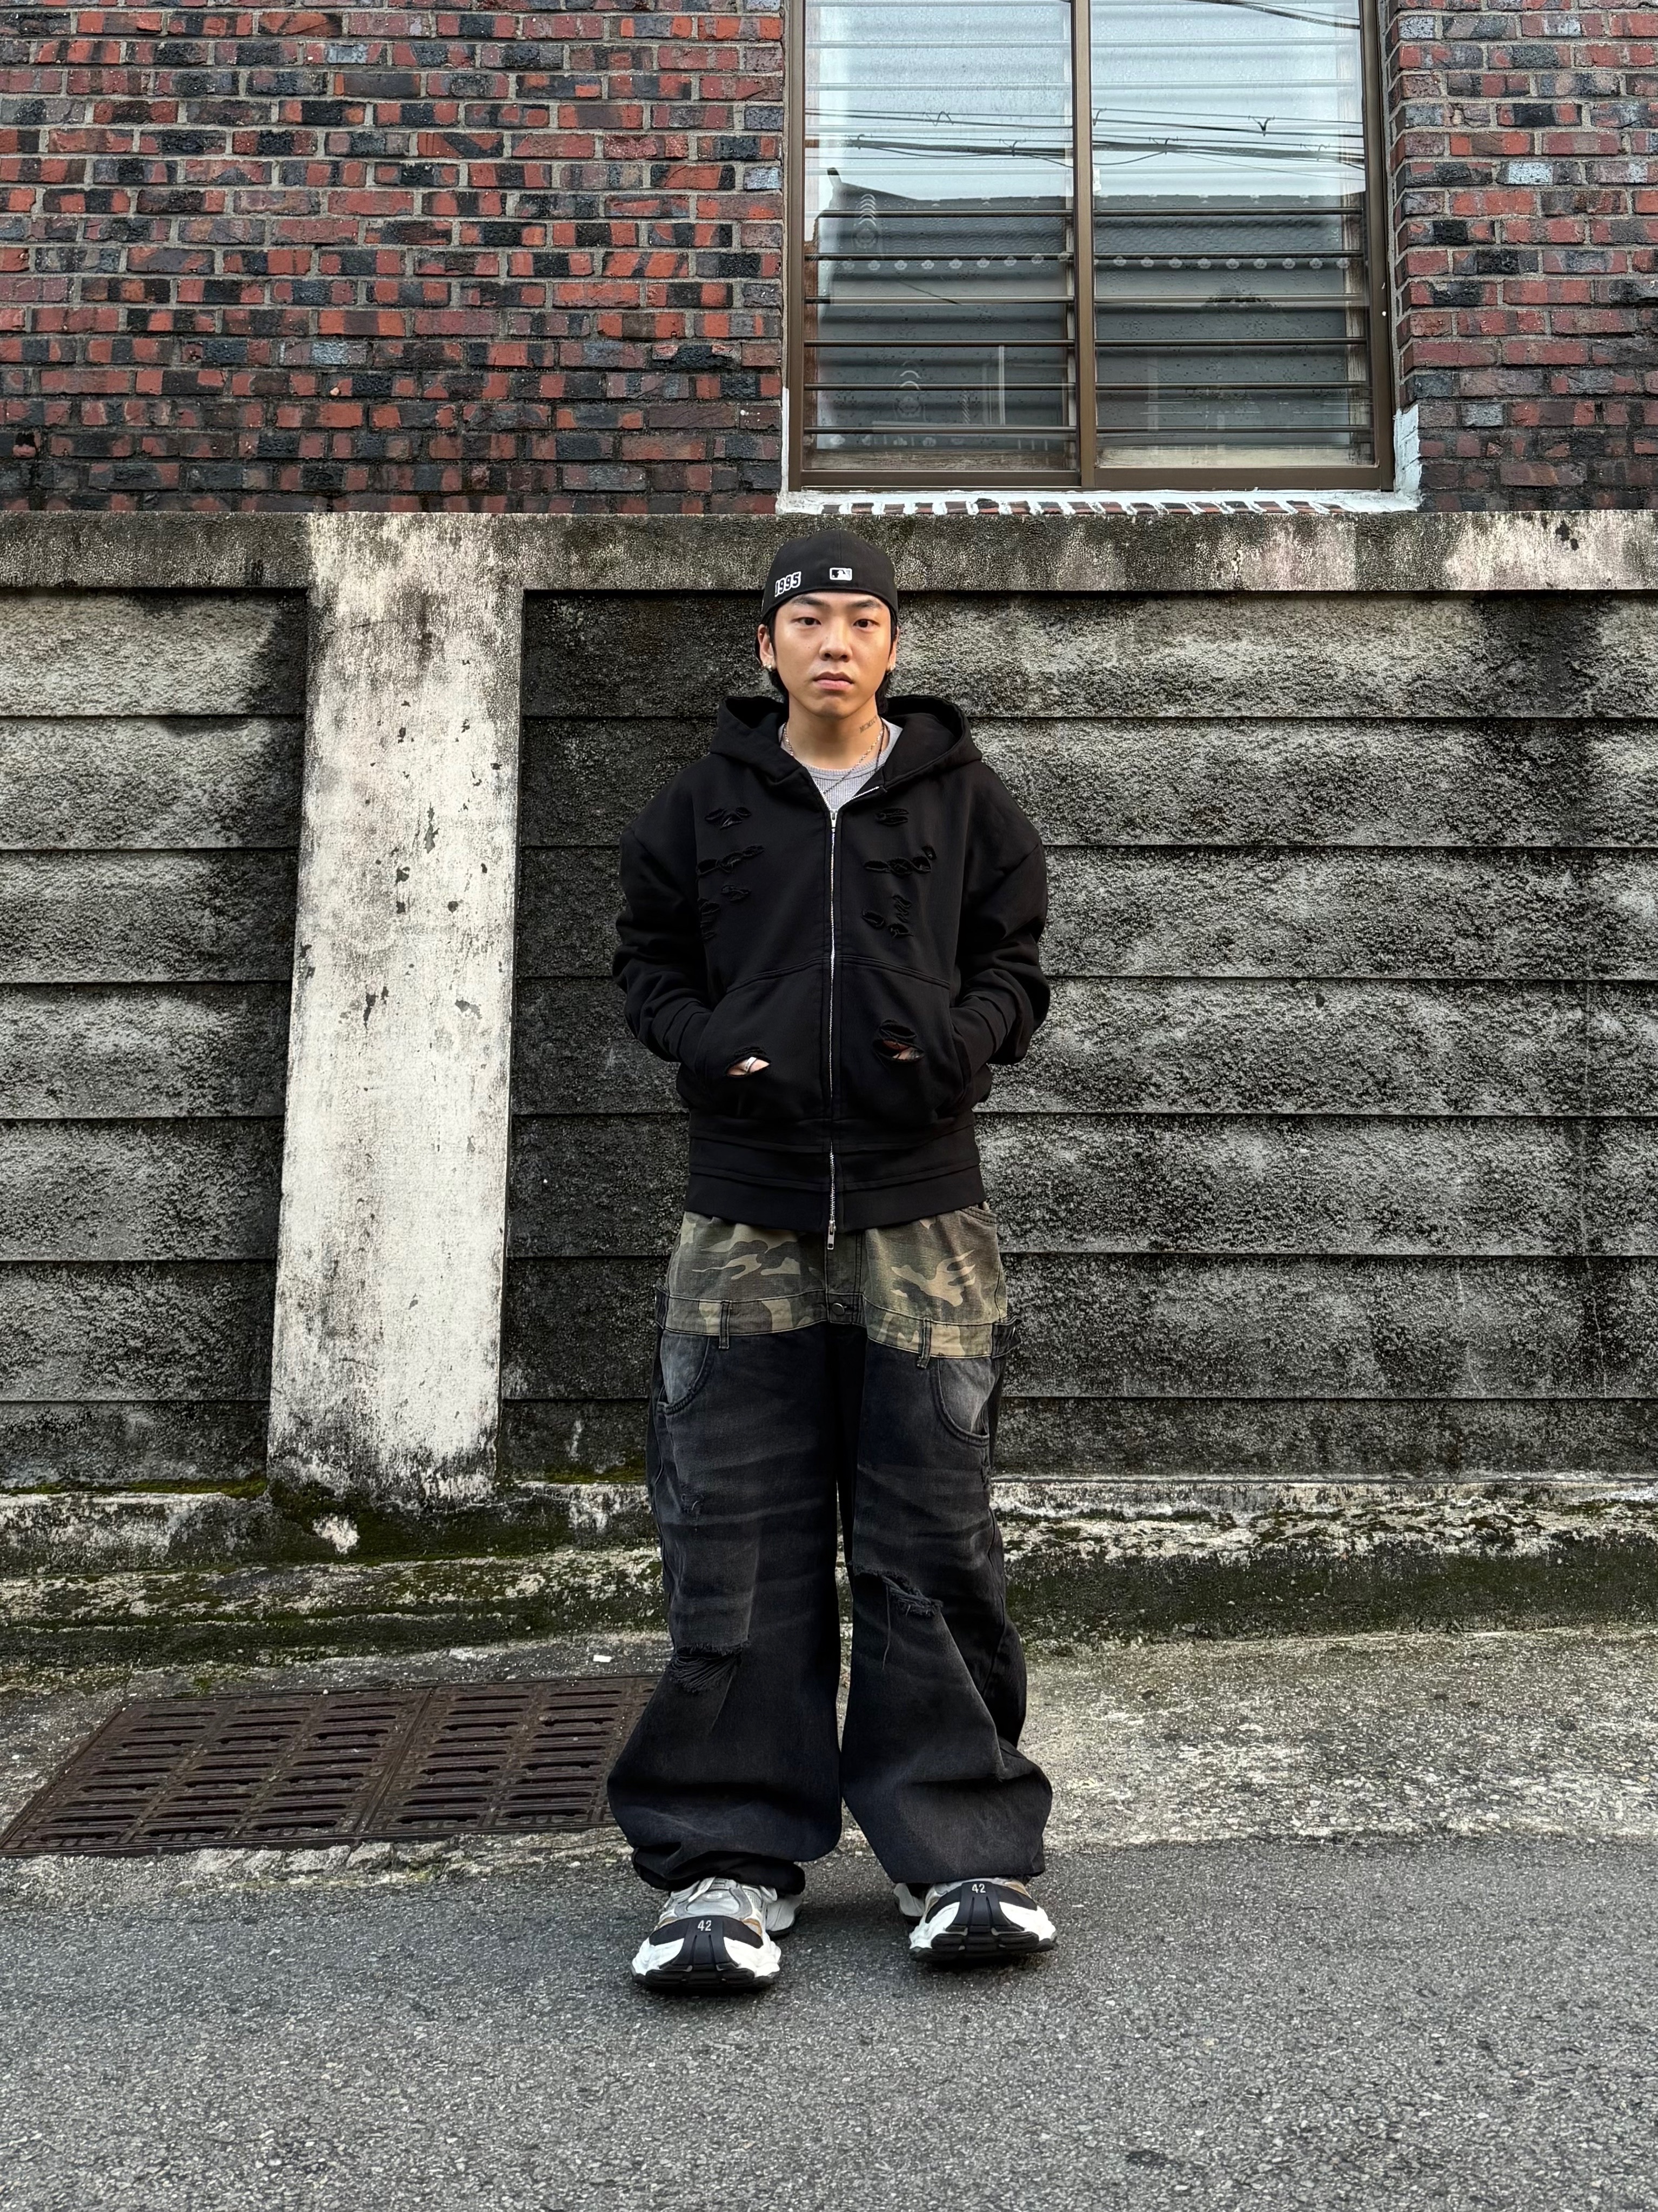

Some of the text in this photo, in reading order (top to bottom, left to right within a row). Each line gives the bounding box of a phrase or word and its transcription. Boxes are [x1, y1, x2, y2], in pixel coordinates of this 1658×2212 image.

[775, 571, 801, 597] 1995
[972, 1883, 986, 1894] 42
[698, 1920, 712, 1931] 42
